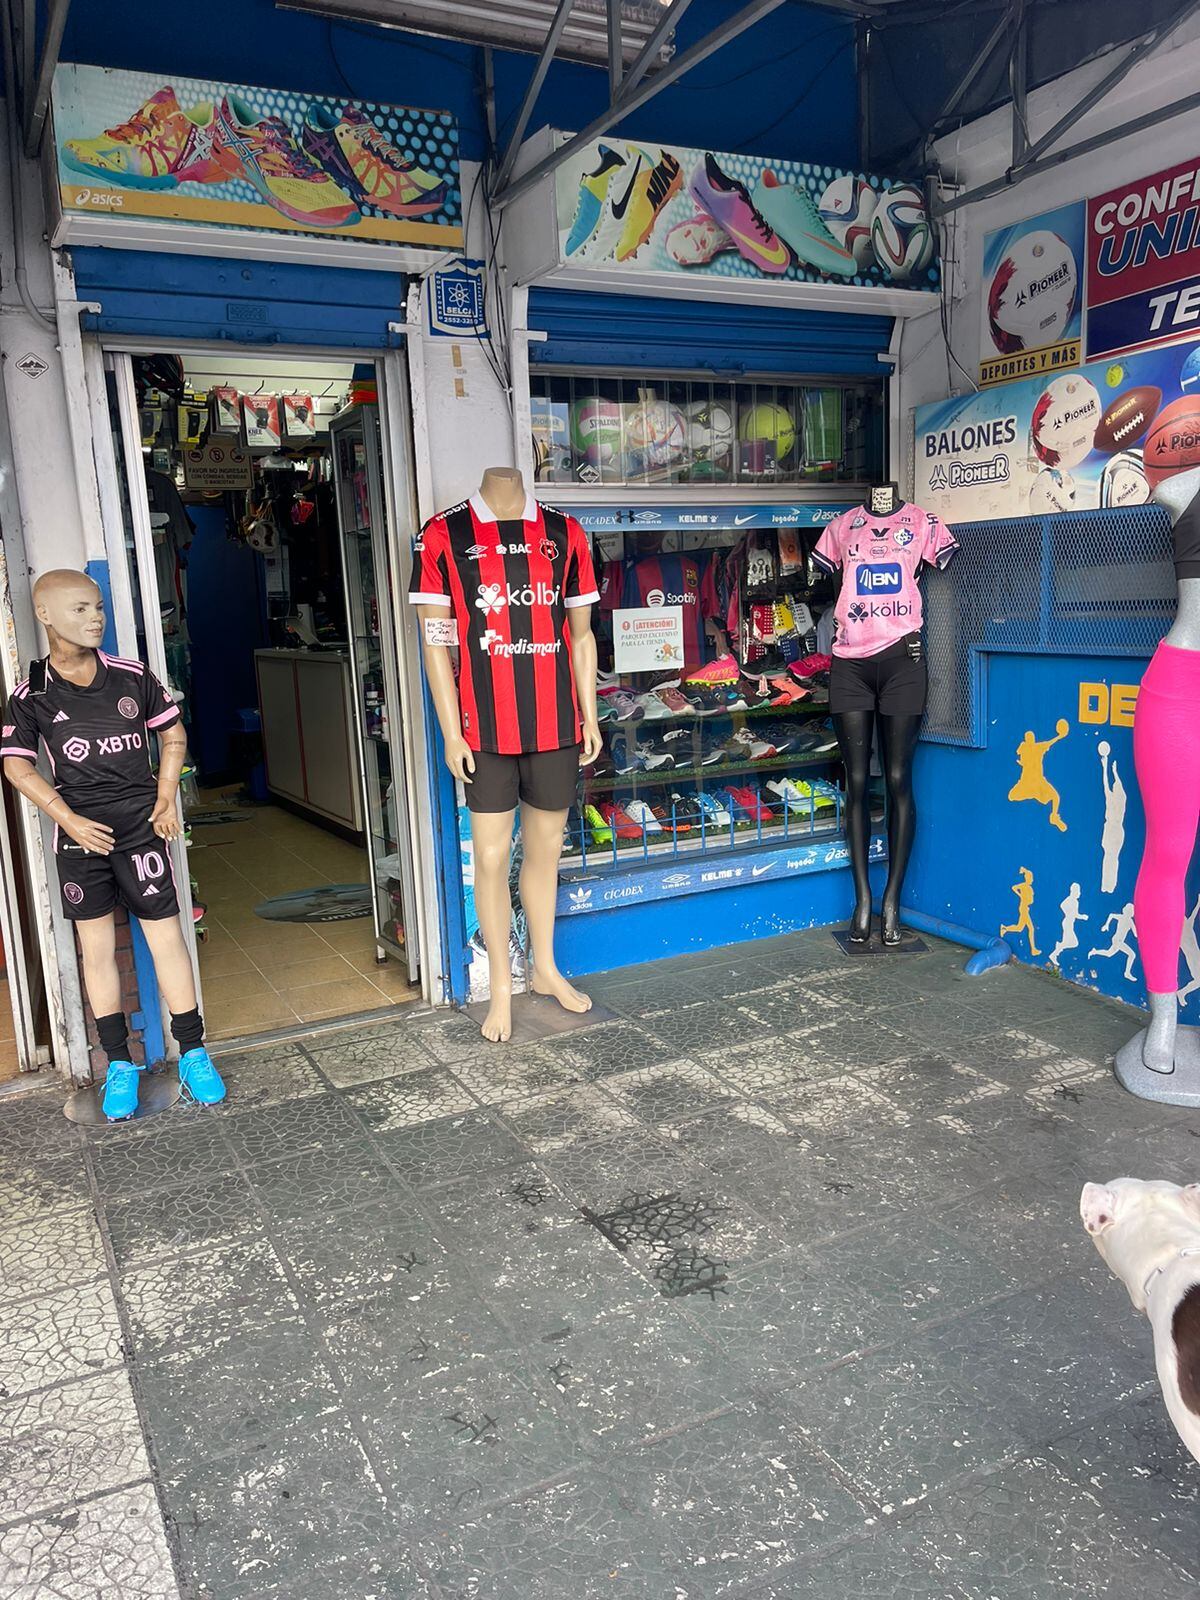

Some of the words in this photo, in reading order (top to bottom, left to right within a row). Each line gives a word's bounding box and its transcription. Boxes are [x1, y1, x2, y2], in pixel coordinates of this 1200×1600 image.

[91, 193, 123, 206] asics
[1097, 205, 1200, 277] UNI
[1029, 262, 1071, 298] PIONEER
[981, 356, 1036, 381] DEPORTES
[1040, 353, 1047, 367] Y
[1051, 346, 1076, 366] MÁS
[1064, 399, 1096, 424] PIONEER
[926, 418, 1016, 457] BALONES
[950, 455, 1008, 487] PIONEER
[679, 514, 708, 523] KELME
[771, 513, 799, 524] Jugador
[508, 543, 532, 554] BAC
[872, 571, 899, 586] BN
[506, 582, 560, 606] kölbi
[667, 592, 697, 605] Spotify
[870, 601, 912, 617] kölbi
[635, 620, 673, 630] ¡ATENCIÓN!
[620, 632, 648, 640] PARQUEO
[494, 639, 561, 658] medismart
[96, 733, 142, 755] XBTO
[131, 851, 165, 881] 10
[701, 869, 733, 882] KELME
[569, 902, 593, 911] adidas
